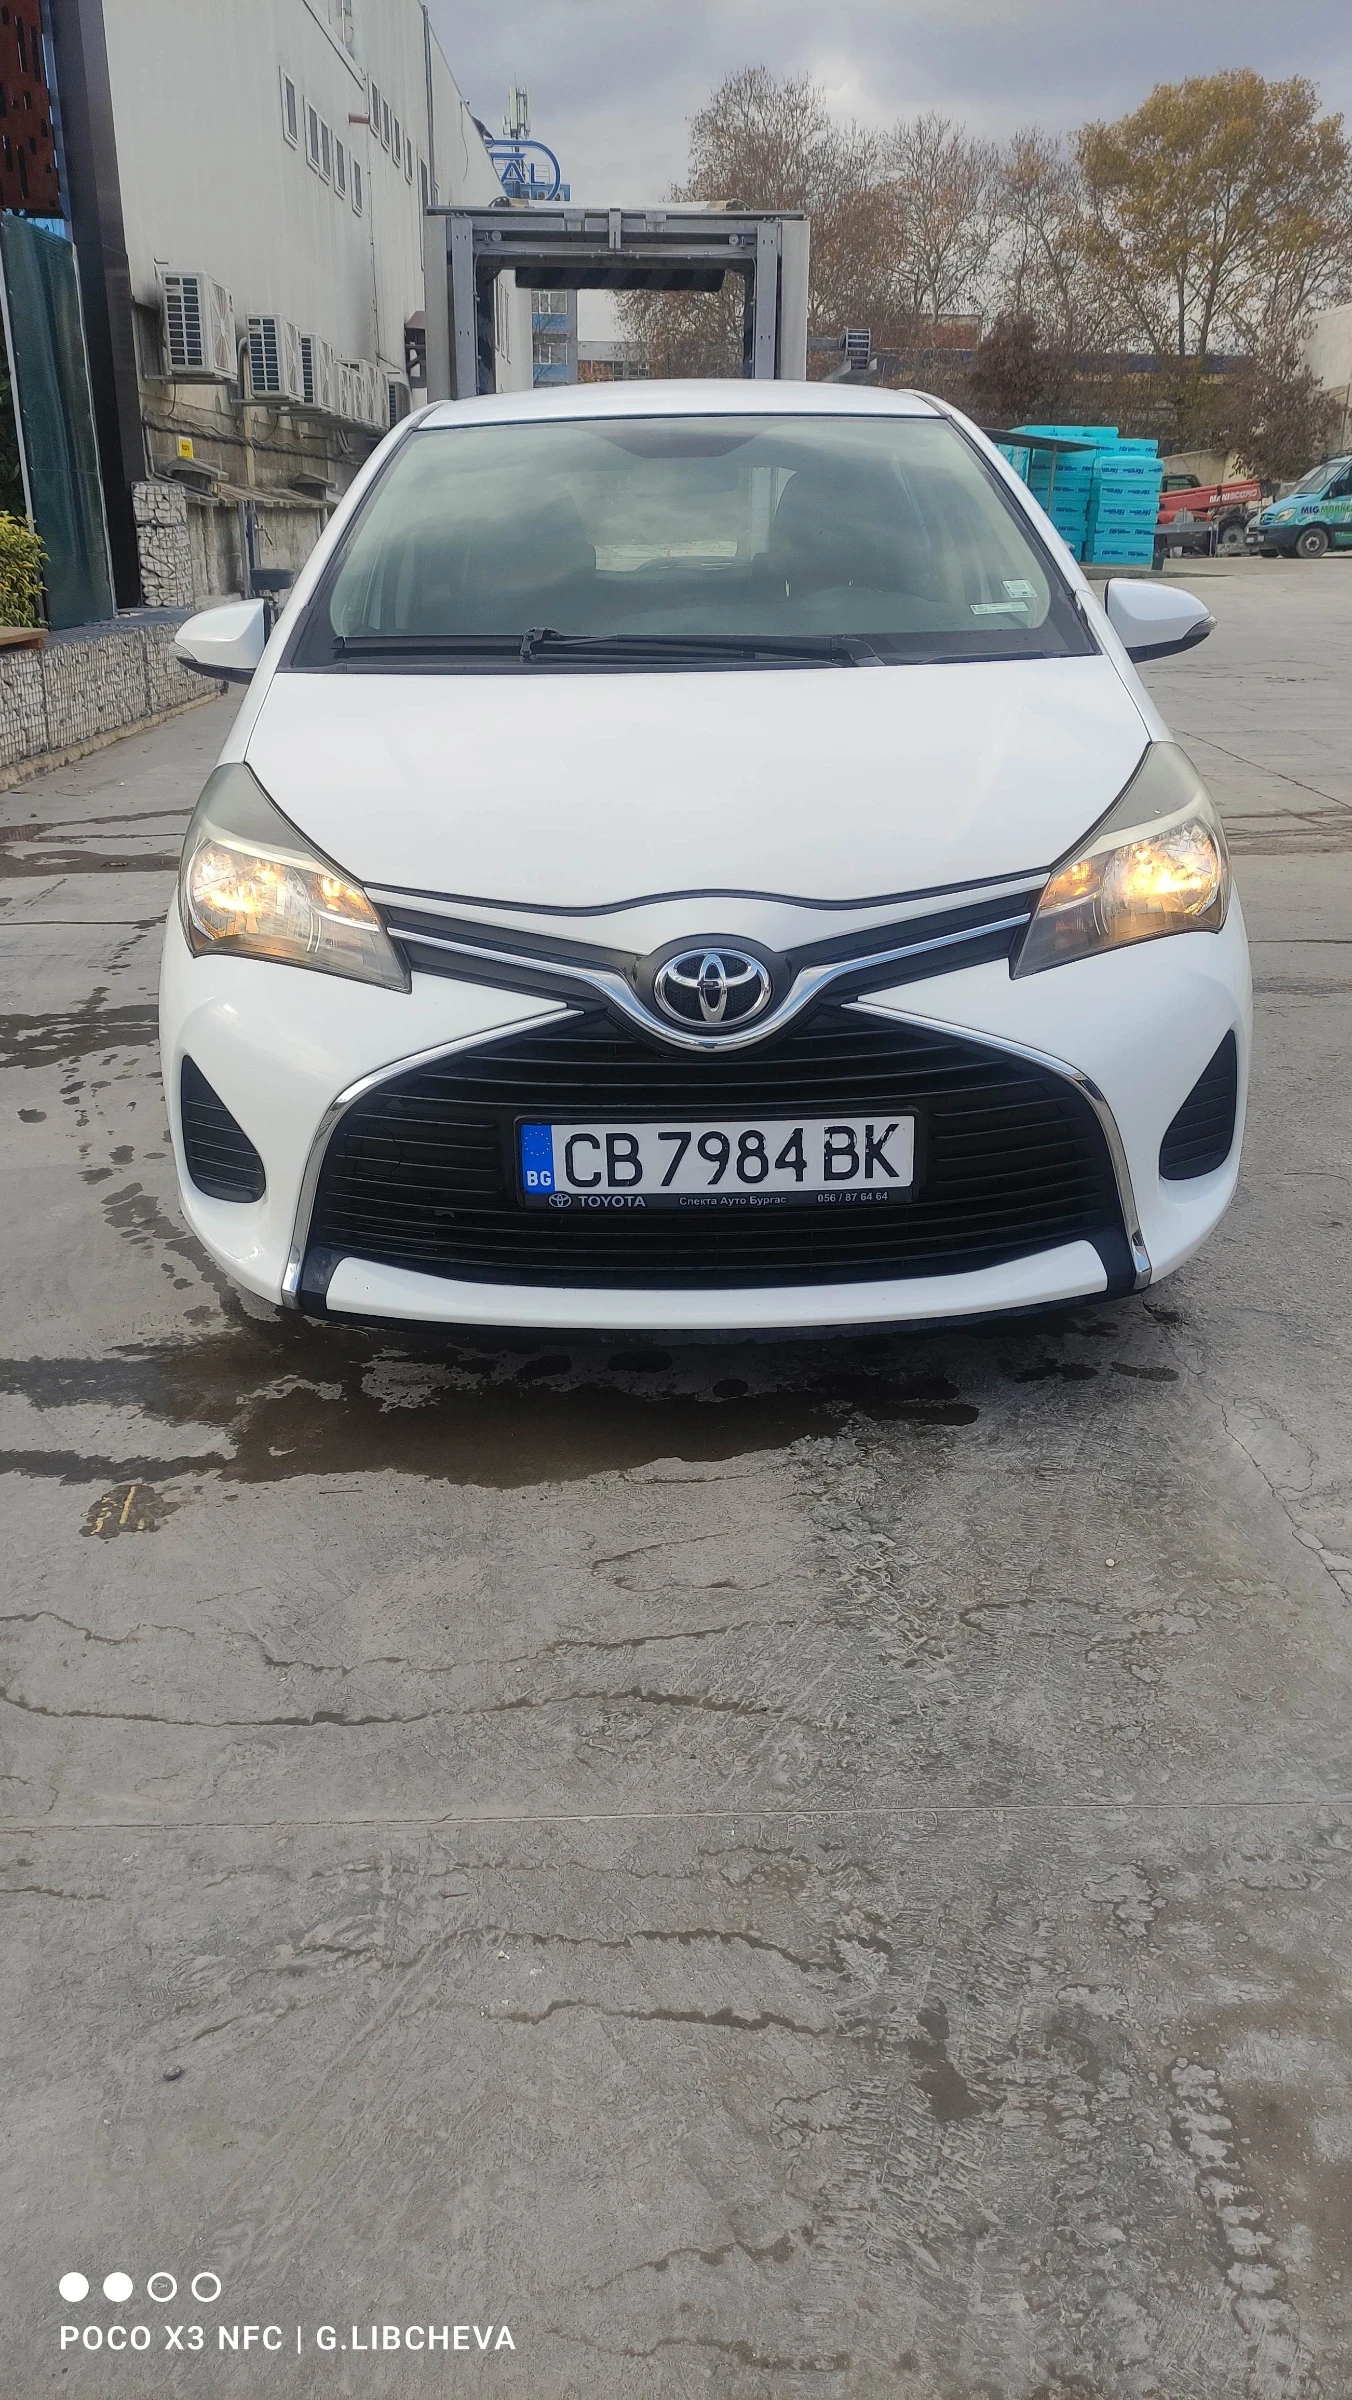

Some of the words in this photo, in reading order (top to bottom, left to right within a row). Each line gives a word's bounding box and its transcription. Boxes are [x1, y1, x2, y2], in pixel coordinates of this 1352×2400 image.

[564, 1132, 643, 1188] CB
[657, 1127, 808, 1187] 7984
[823, 1123, 900, 1182] BK
[526, 1170, 552, 1187] BG
[577, 1195, 646, 1208] TOYOTA
[679, 1196, 718, 1207] Спекта
[720, 1196, 747, 1208] Ауто
[749, 1195, 787, 1206] Бургас
[817, 1193, 836, 1203] 056
[845, 1192, 857, 1202] 87
[860, 1192, 872, 1201] 64
[875, 1191, 888, 1201] 64
